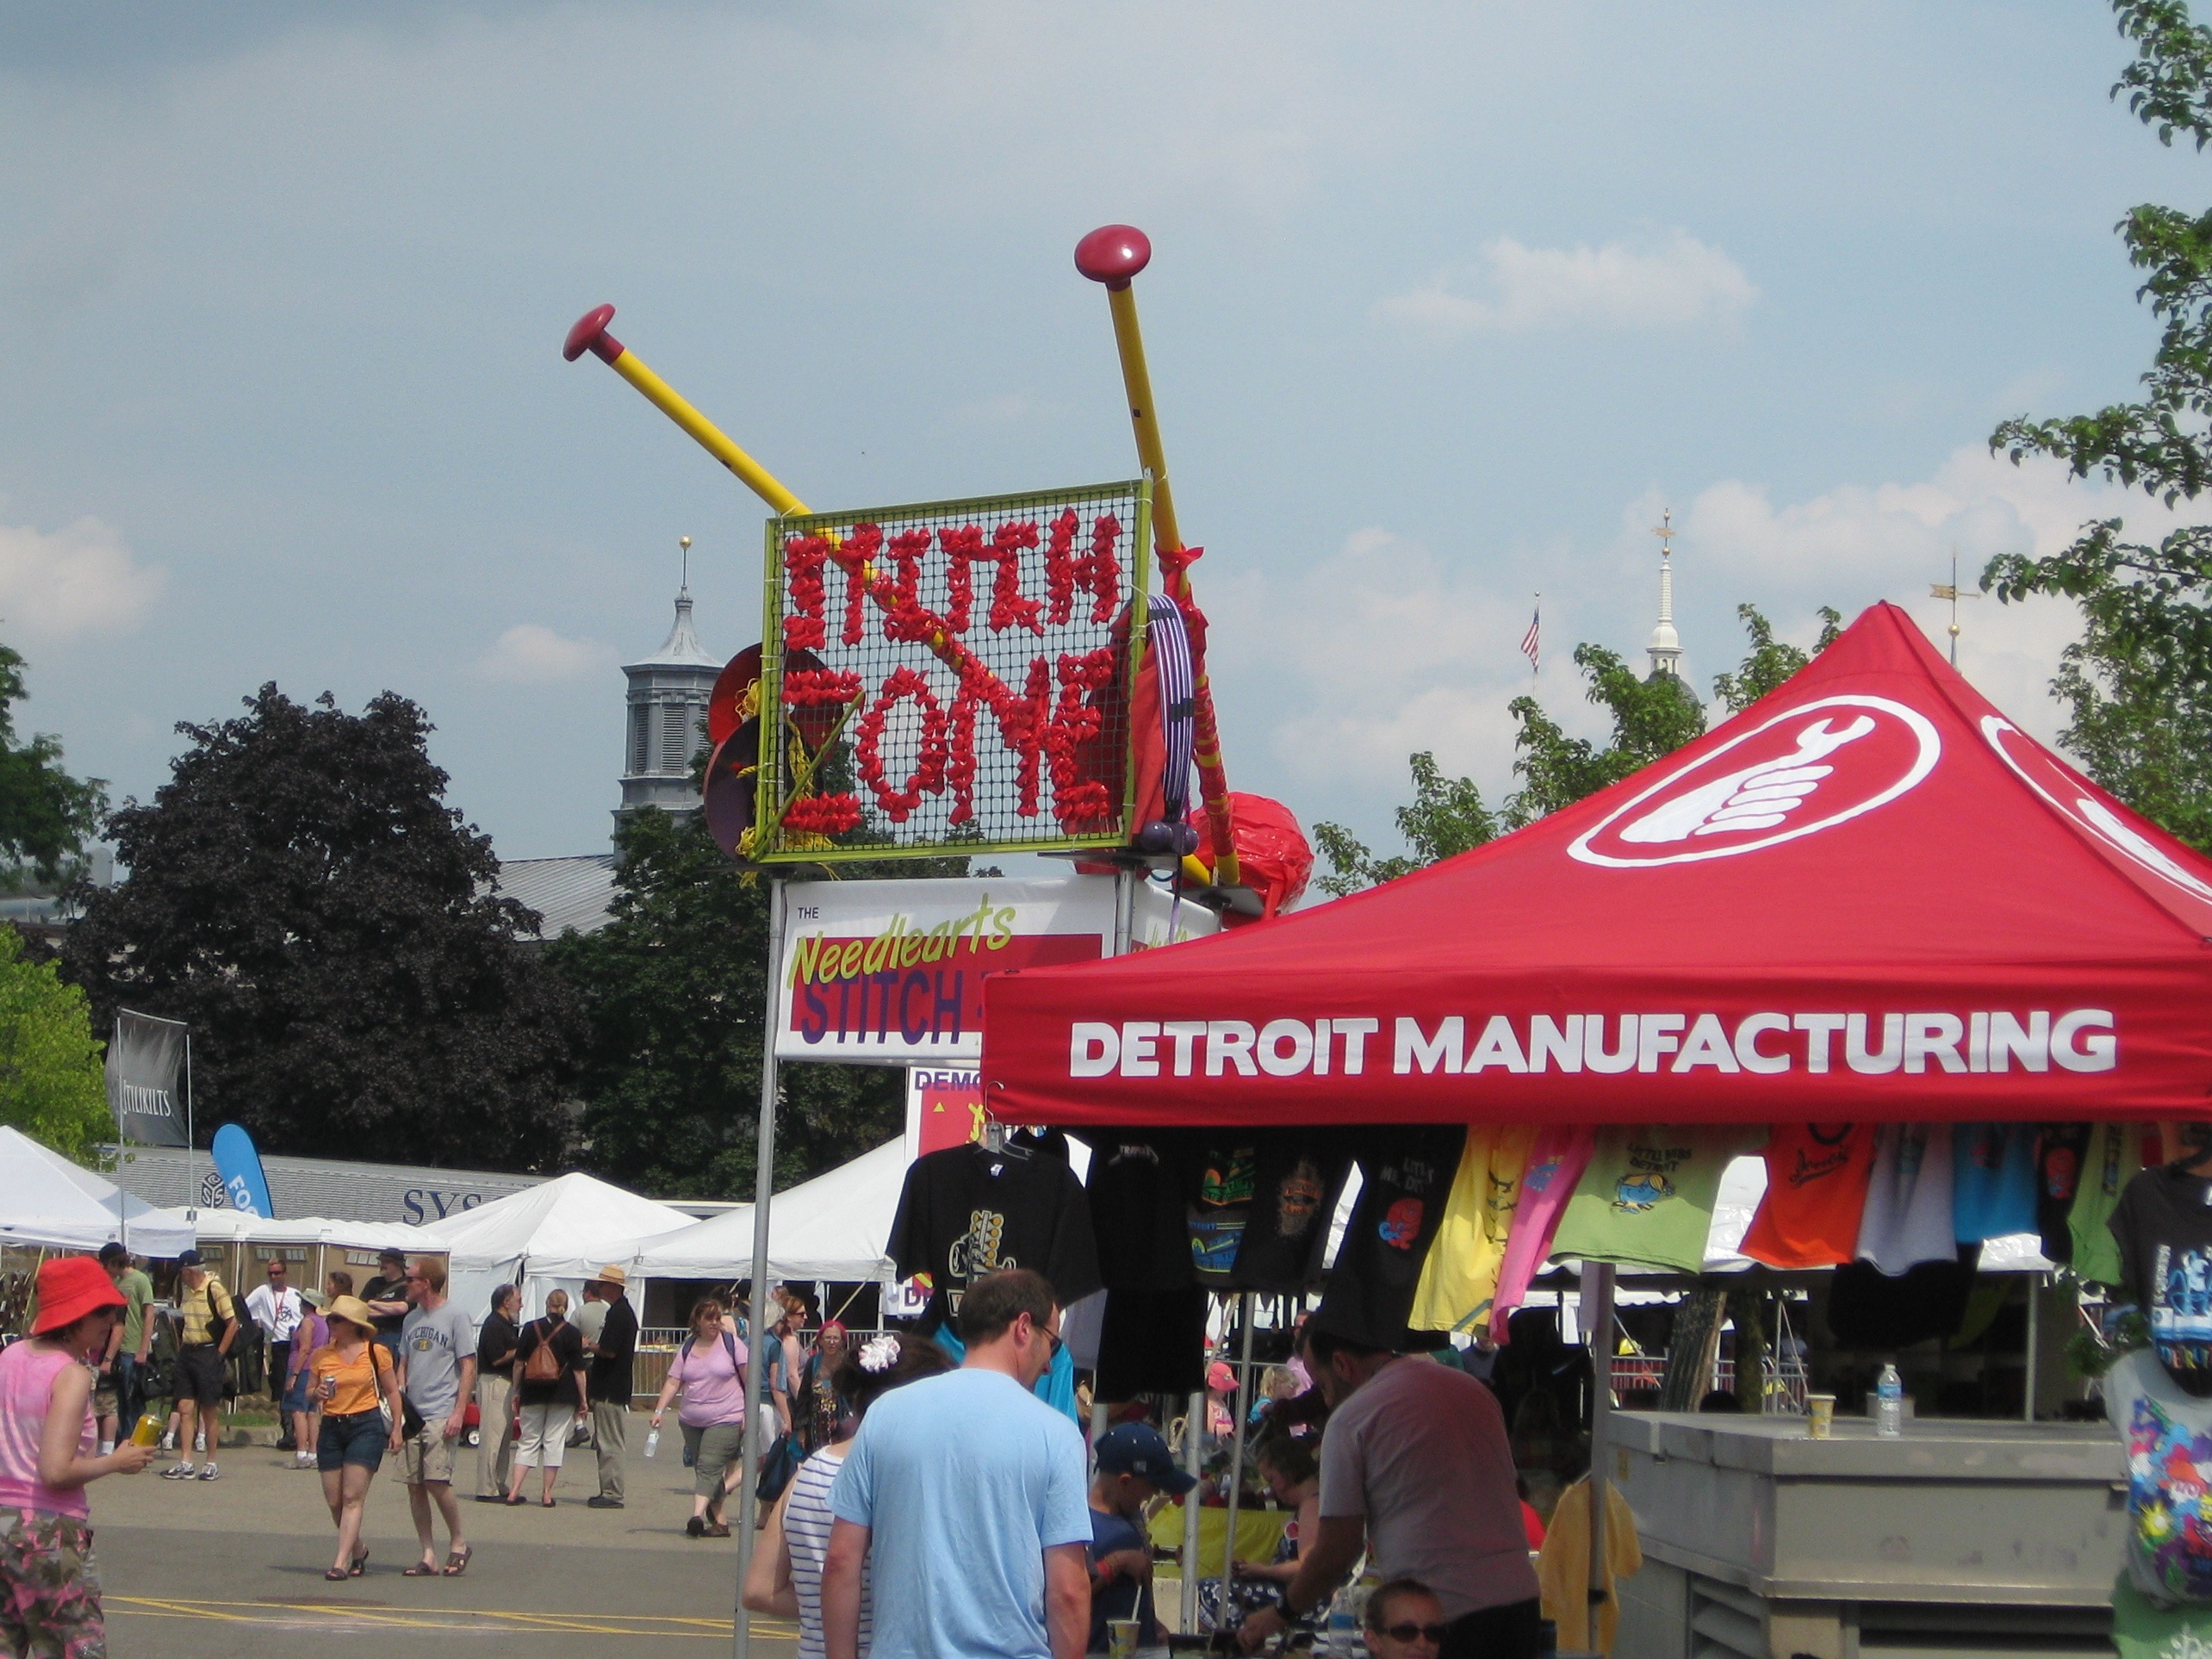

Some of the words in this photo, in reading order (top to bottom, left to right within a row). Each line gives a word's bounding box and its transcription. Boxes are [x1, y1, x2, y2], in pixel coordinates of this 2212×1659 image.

[784, 506, 1121, 651] STITCH
[786, 892, 1016, 990] Needlearts
[798, 907, 819, 919] THE
[801, 969, 963, 1045] STITCH
[1069, 1018, 1378, 1078] DETROIT
[1392, 1009, 2117, 1075] MANUFACTURING
